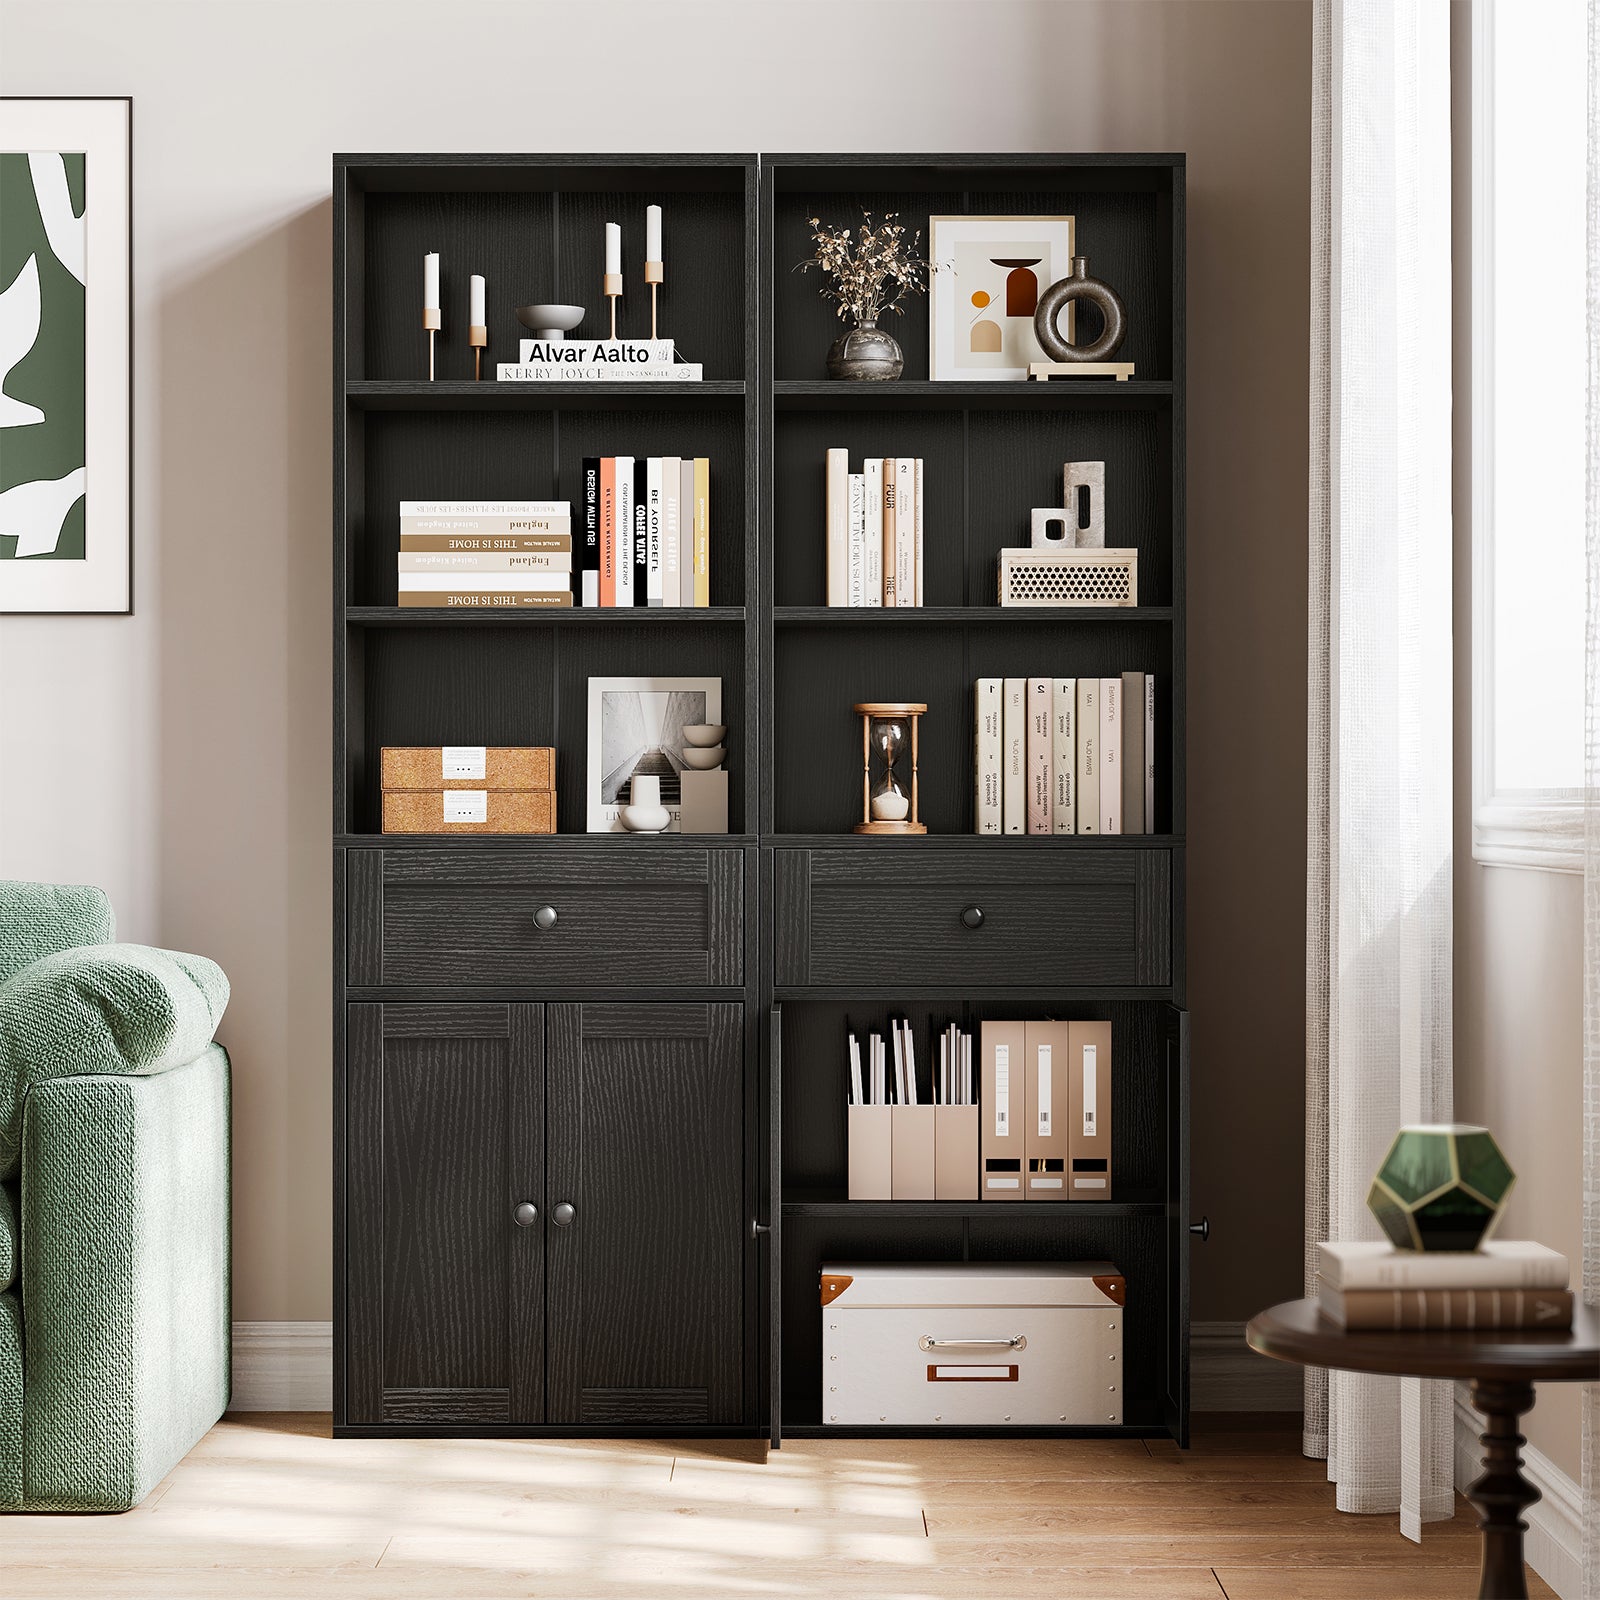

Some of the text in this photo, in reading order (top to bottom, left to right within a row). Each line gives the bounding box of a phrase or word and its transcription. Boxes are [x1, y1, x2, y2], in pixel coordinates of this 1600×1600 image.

[529, 343, 587, 363] Alvar
[592, 343, 650, 363] Aalto
[504, 367, 605, 380] KERRY JOYCE
[871, 465, 876, 473] 1
[900, 465, 909, 474] 2
[886, 483, 896, 509] PUUR
[509, 520, 550, 530] England
[448, 540, 518, 549] THIS IS HOME
[509, 556, 550, 566] England
[886, 575, 896, 596] THEE
[447, 596, 517, 605] THIS IS HOME
